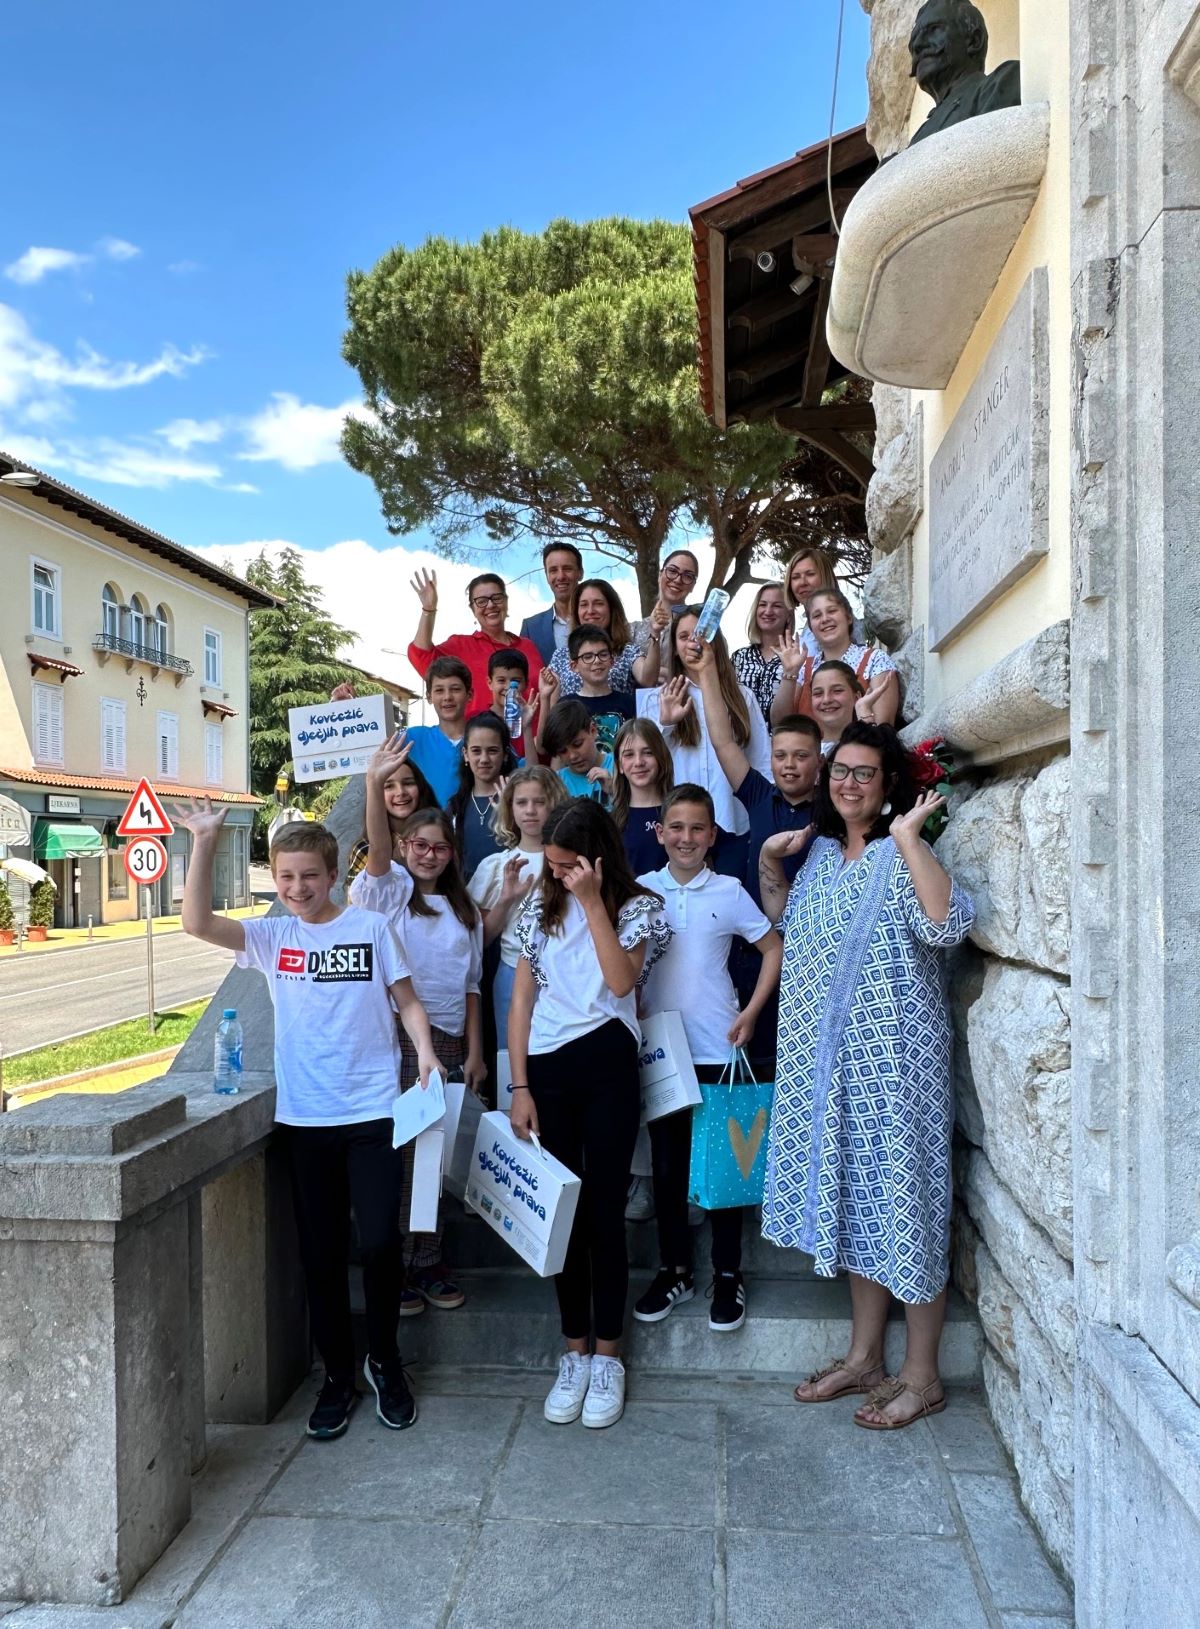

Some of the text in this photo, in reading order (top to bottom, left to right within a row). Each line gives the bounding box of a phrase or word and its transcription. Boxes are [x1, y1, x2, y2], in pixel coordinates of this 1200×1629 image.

[973, 365, 1009, 443] STANGER
[342, 721, 379, 738] prava
[51, 799, 79, 809] LJEKARNA
[133, 849, 158, 872] 30
[308, 948, 369, 974] DIESEL
[492, 1141, 539, 1191] Kovčežić
[513, 1184, 546, 1222] prava
